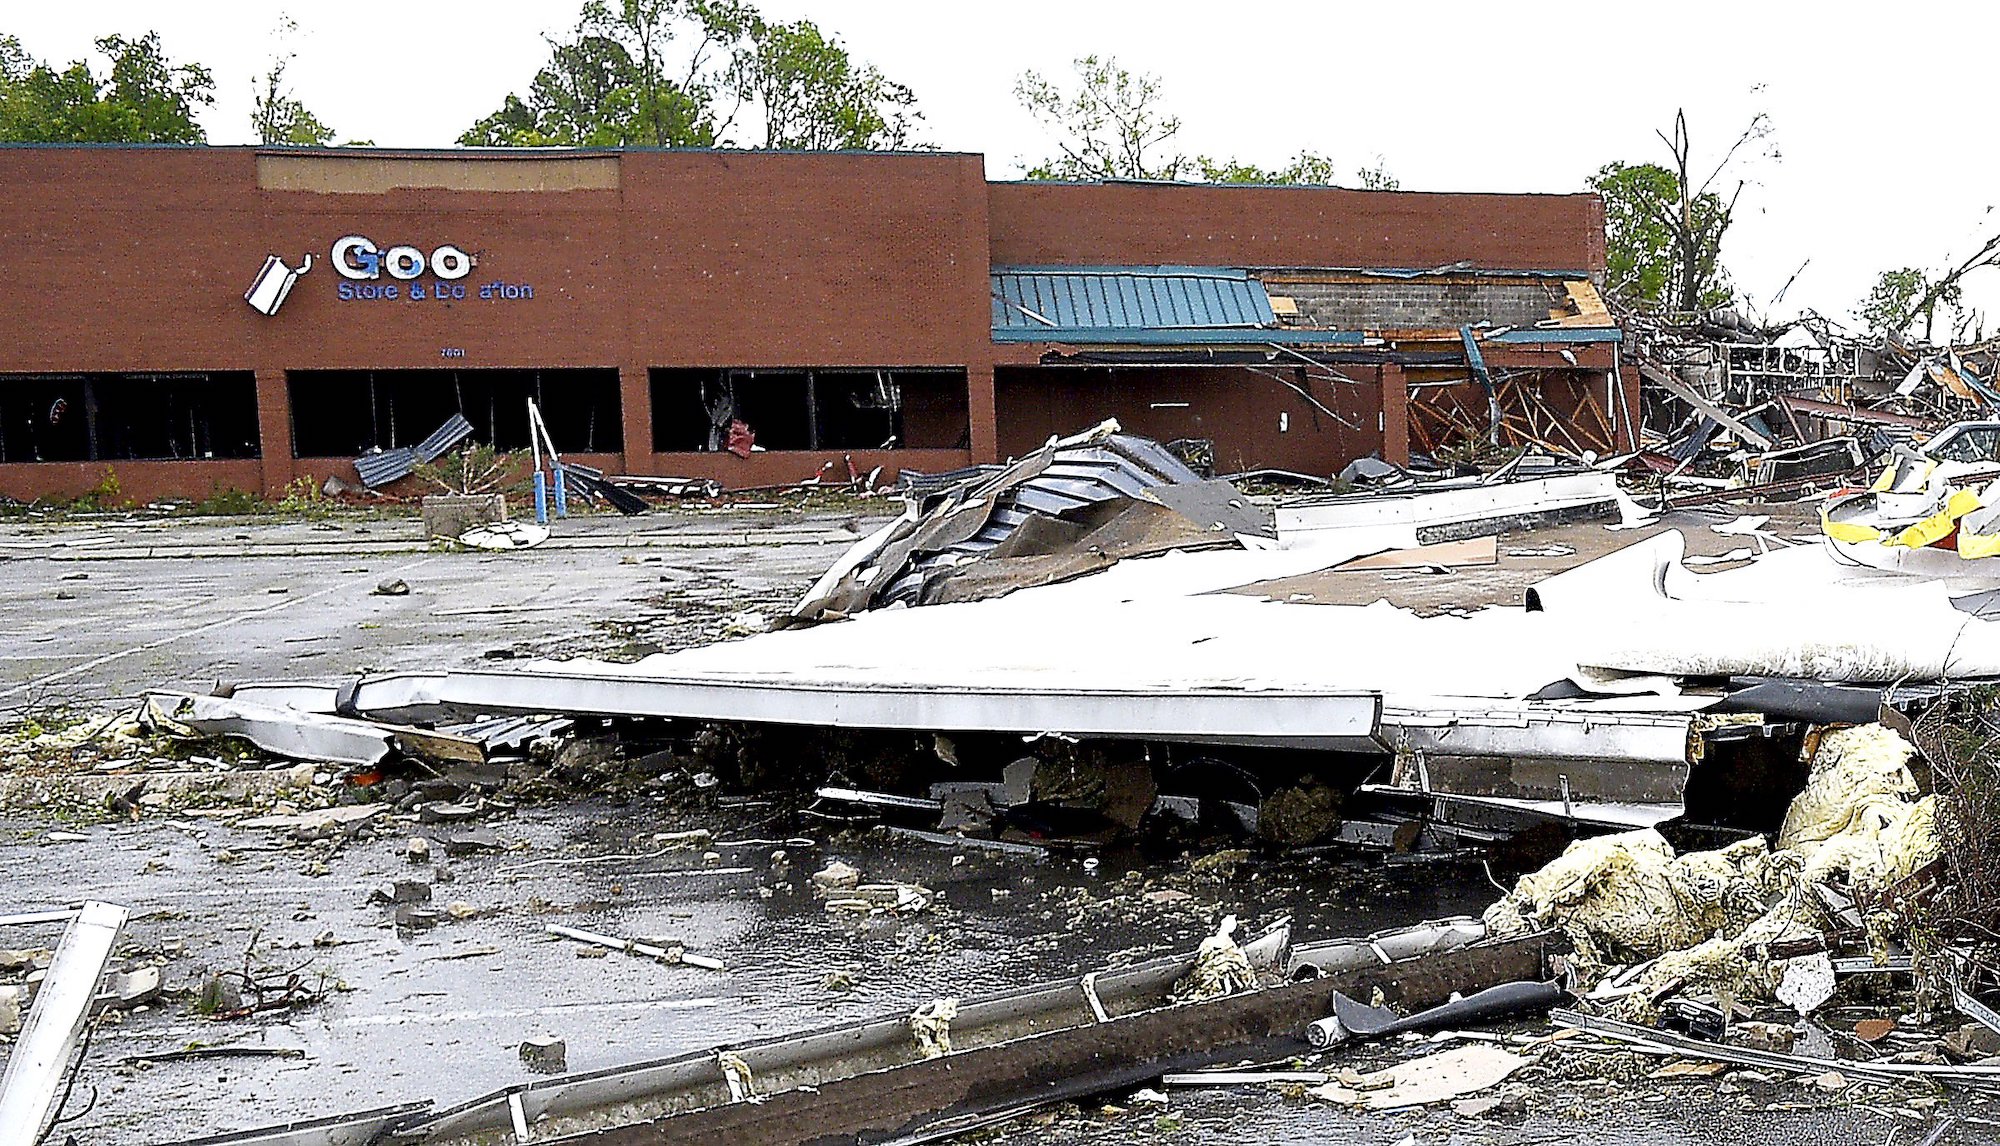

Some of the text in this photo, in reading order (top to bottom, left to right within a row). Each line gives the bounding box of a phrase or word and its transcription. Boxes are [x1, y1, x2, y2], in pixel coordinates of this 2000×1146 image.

[332, 235, 471, 280] Goo
[338, 281, 399, 300] Store
[410, 280, 426, 300] &
